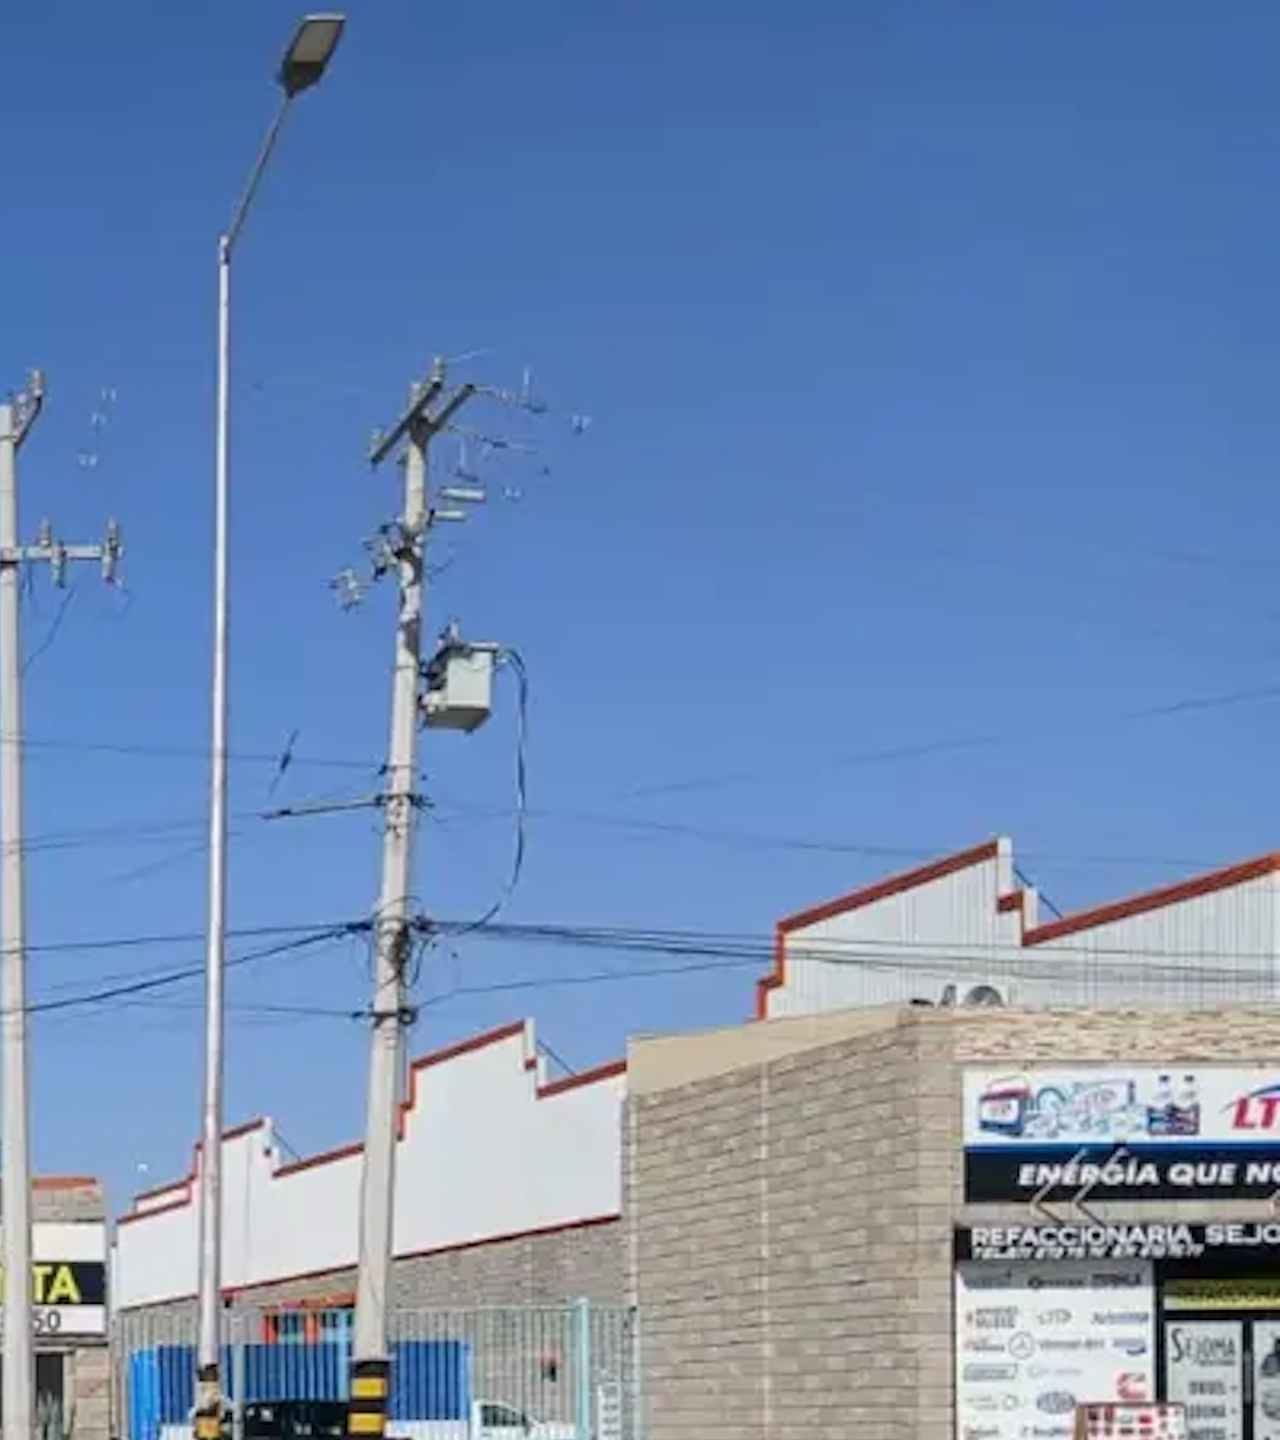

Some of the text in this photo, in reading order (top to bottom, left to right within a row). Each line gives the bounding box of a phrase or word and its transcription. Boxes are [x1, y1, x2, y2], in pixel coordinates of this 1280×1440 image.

[1017, 1160, 1159, 1186] ENERGÍA
[1168, 1163, 1237, 1186] QUE
[971, 1224, 1193, 1247] REFACCIONARIA
